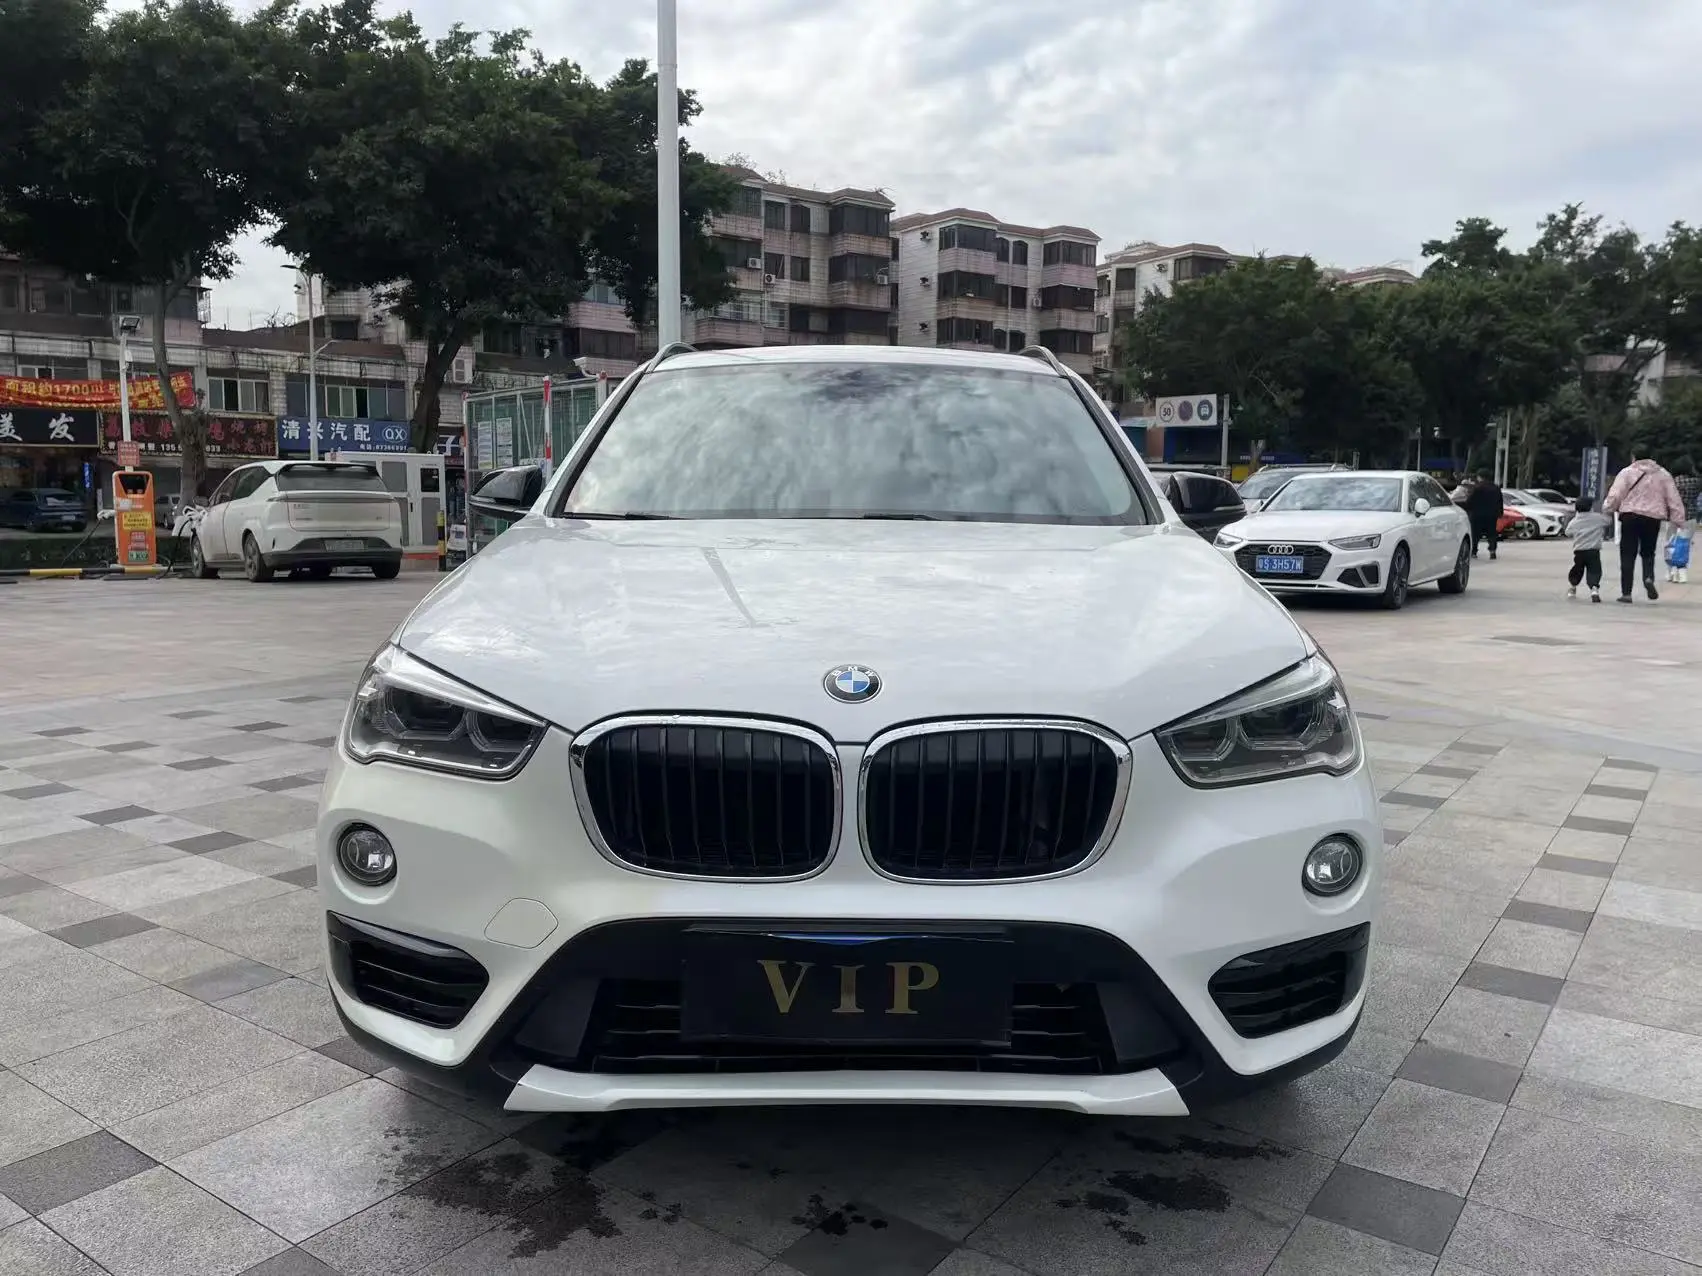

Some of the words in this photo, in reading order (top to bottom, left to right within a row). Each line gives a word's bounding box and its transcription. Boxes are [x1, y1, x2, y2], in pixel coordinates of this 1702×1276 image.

[385, 429, 405, 440] QX
[831, 665, 875, 677] BMW
[757, 959, 940, 1014] VIP
